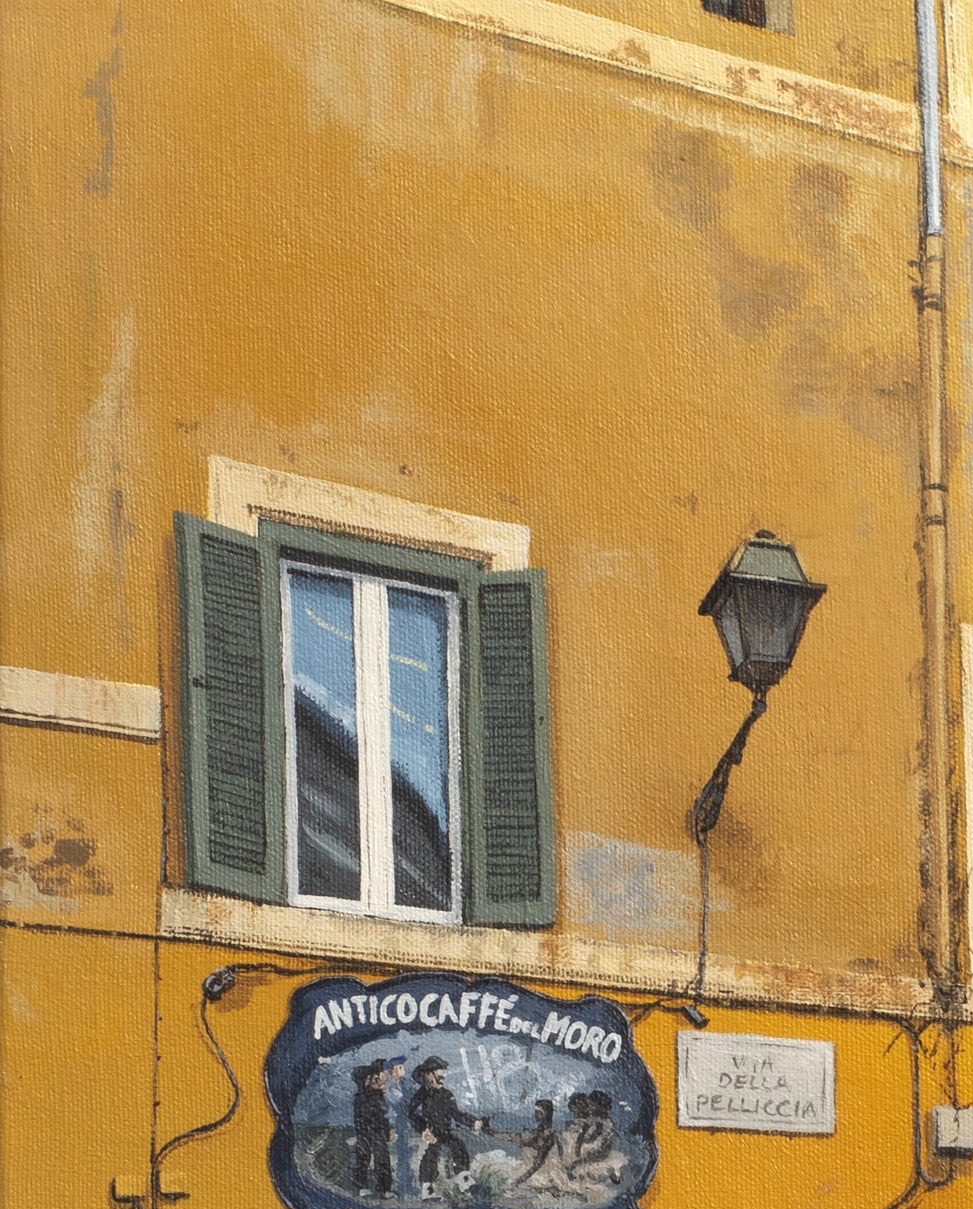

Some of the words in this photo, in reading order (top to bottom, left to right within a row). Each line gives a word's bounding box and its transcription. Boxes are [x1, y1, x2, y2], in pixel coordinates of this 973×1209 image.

[540, 1010, 623, 1064] MORO
[731, 1054, 774, 1074] VIA
[718, 1072, 791, 1092] DELLA
[696, 1094, 817, 1119] PELLICCIA
